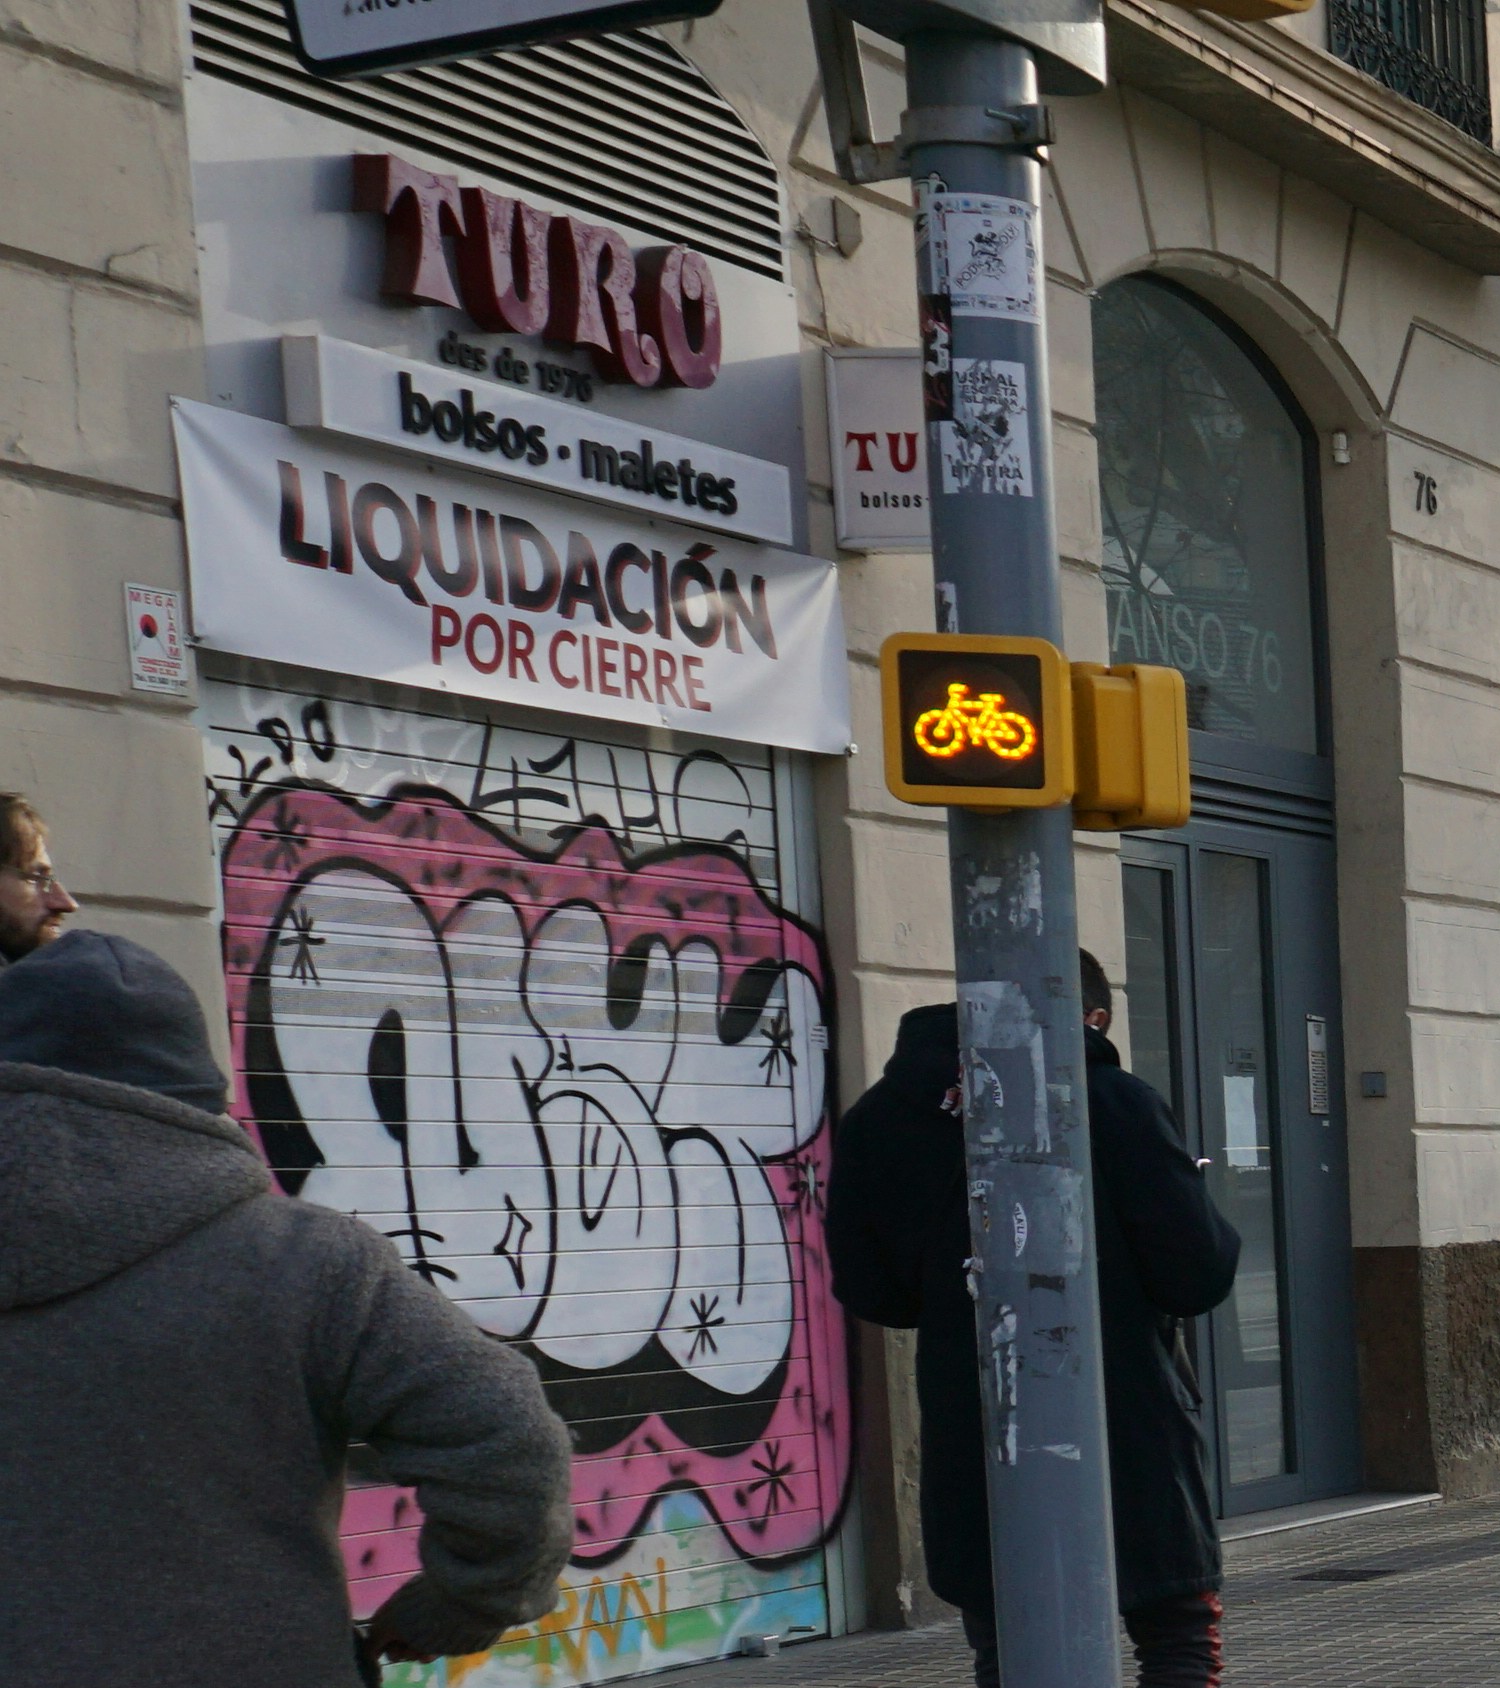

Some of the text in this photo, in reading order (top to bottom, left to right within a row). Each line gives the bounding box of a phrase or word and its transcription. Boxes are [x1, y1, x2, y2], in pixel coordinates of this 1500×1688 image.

[353, 152, 722, 389] TURO
[439, 331, 594, 402] des de 1976
[397, 371, 738, 516] bolsos maletes
[860, 491, 922, 509] bolsos
[1413, 470, 1438, 516] 76
[277, 459, 778, 659] LIQUIDACIÓN
[431, 603, 712, 712] POR CIERRE
[1238, 623, 1283, 693] 76
